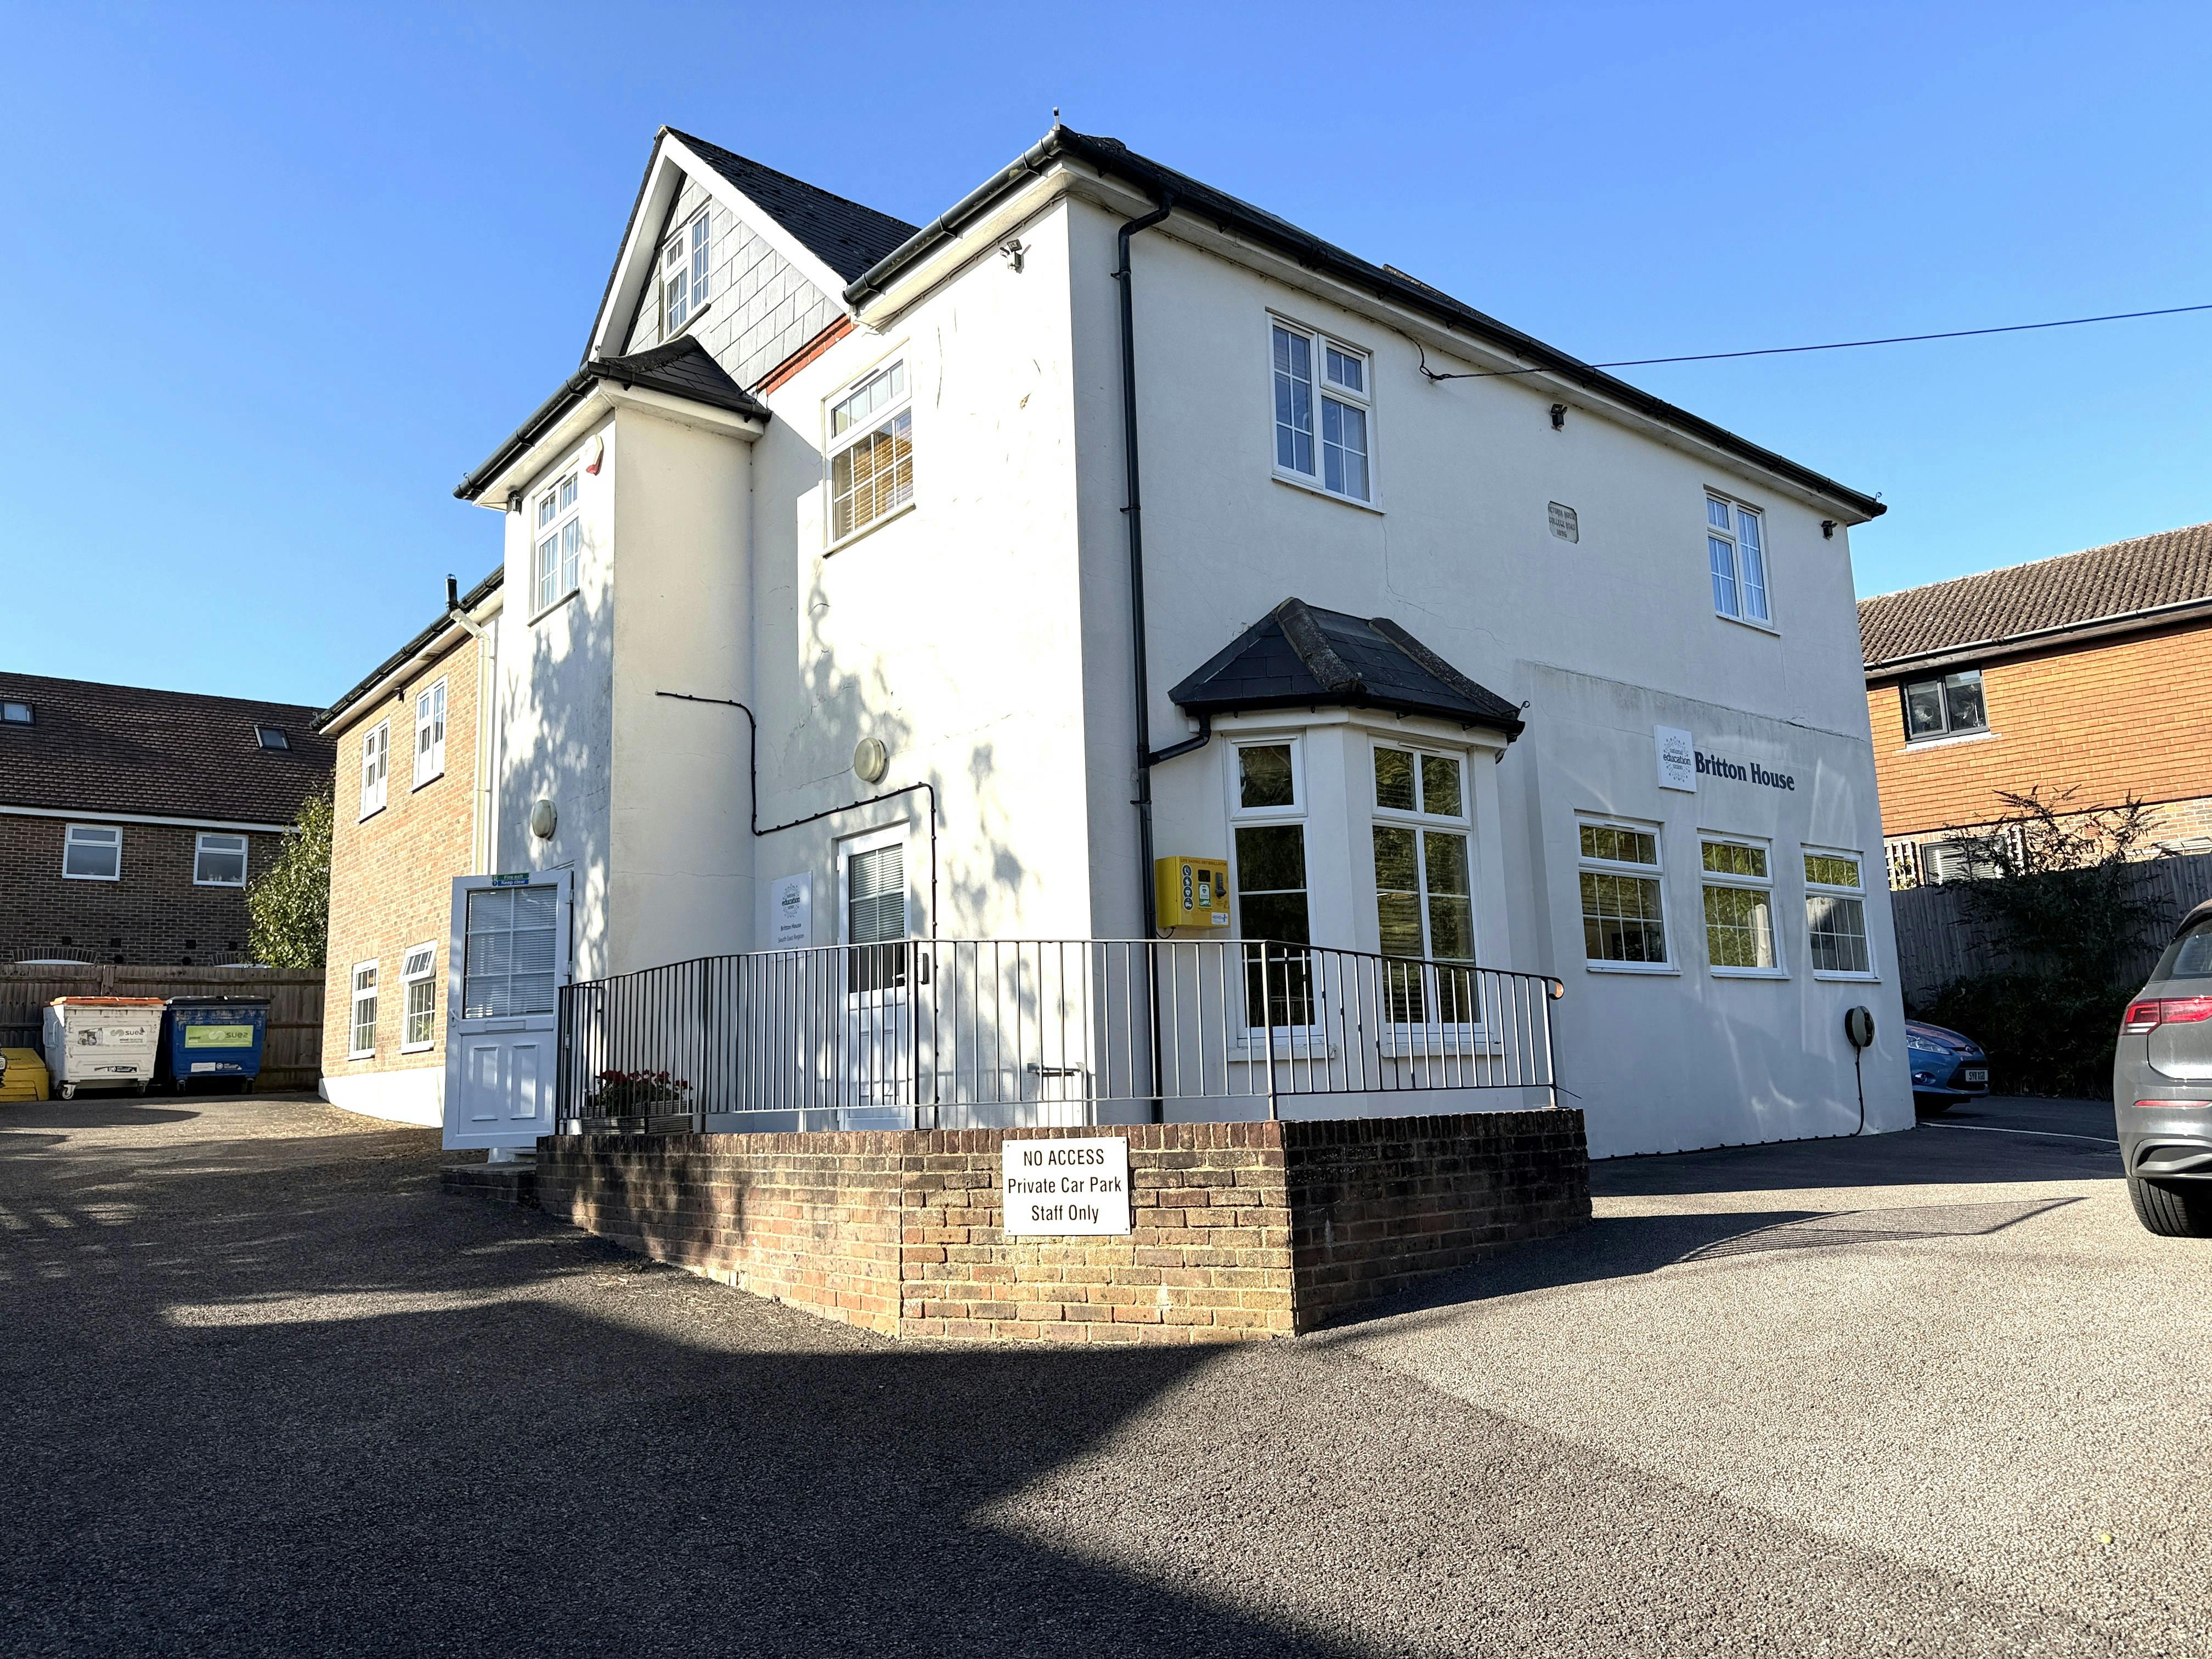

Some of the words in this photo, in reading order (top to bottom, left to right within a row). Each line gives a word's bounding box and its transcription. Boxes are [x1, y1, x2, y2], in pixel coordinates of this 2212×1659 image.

[1549, 516, 1565, 528] COLLEGE
[1566, 522, 1575, 531] ROAD
[1663, 754, 1691, 765] education
[1695, 751, 1747, 781] Britton
[1750, 763, 1795, 791] House
[782, 897, 800, 906] education
[1024, 1150, 1042, 1166] NO
[1048, 1149, 1104, 1165] ACCESS
[1008, 1178, 1056, 1193] Private
[1062, 1177, 1085, 1193] Car
[1090, 1176, 1121, 1192] Park
[1032, 1205, 1063, 1221] Staff
[1069, 1204, 1099, 1224] Only
